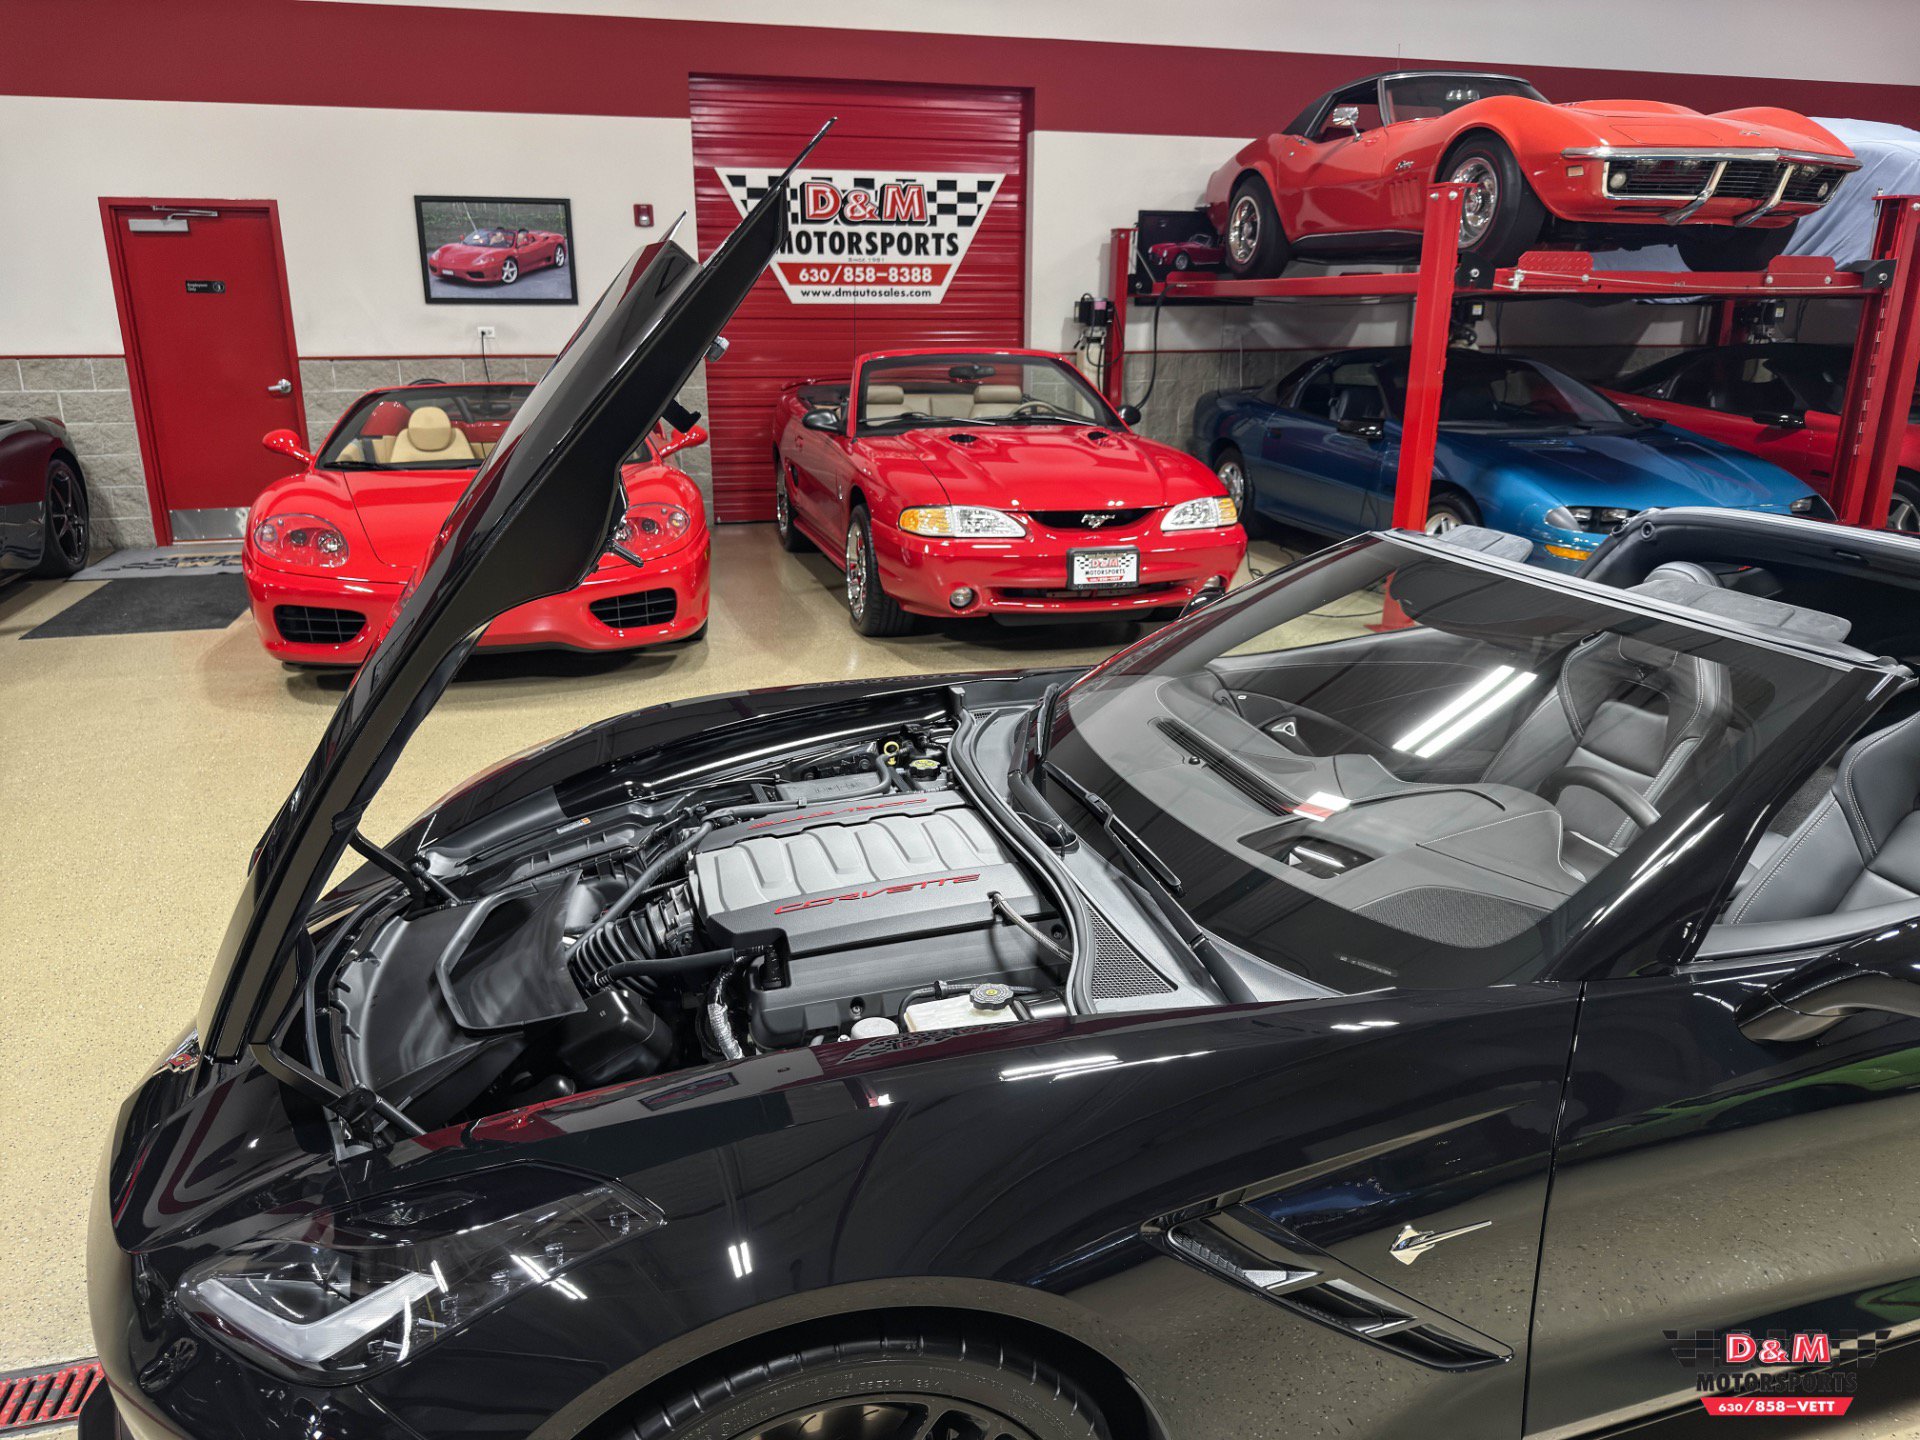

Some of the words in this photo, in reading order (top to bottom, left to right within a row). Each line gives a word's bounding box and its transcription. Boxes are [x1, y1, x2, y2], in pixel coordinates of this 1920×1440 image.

[801, 182, 927, 224] D&M
[800, 287, 932, 298] www.dmautosales.com
[1085, 568, 1126, 576] MOTORSPORTS
[774, 874, 980, 914] CORVETTE
